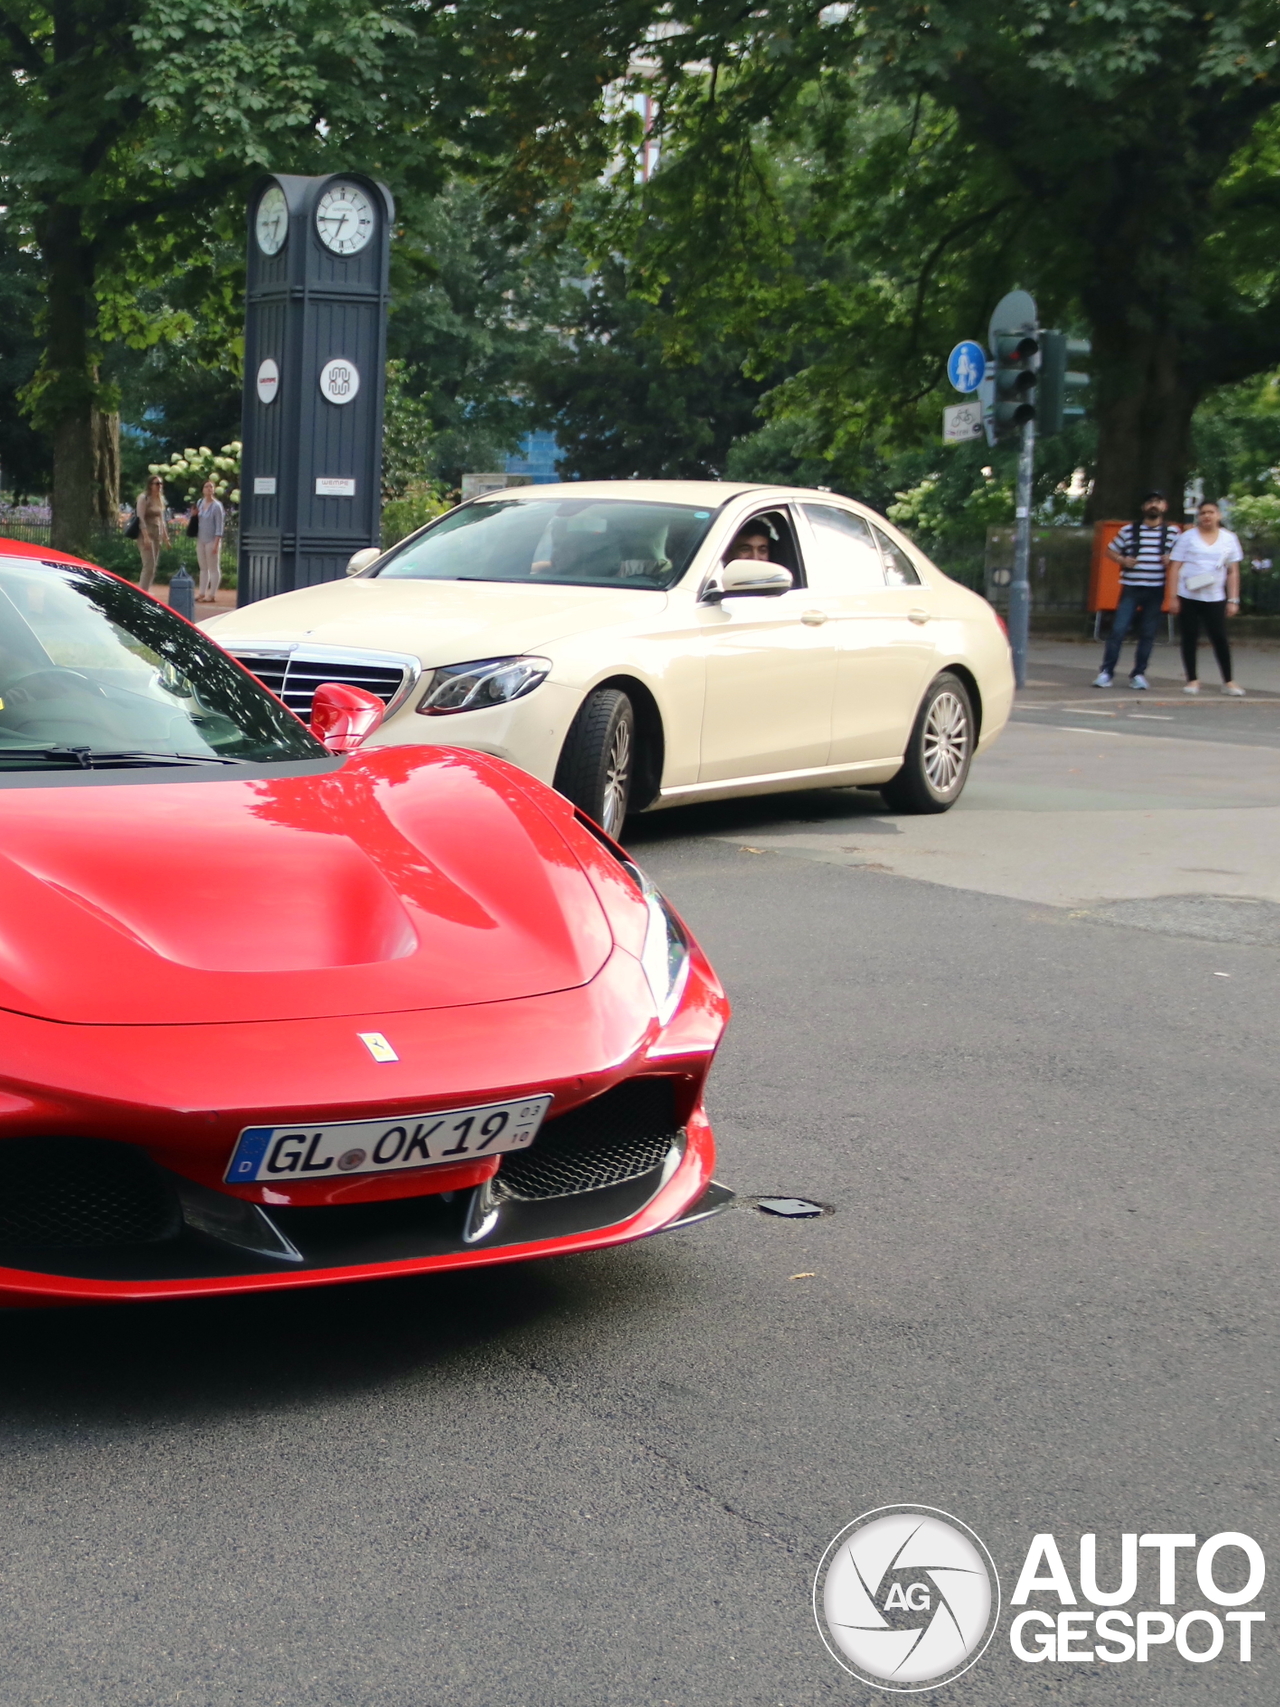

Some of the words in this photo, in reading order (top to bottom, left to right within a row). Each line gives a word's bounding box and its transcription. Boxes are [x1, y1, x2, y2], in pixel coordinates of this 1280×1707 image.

[520, 1105, 541, 1119] 03
[266, 1133, 334, 1173] GL
[372, 1119, 446, 1164] OK
[442, 1111, 510, 1157] 19
[510, 1131, 526, 1144] 10
[238, 1160, 253, 1173] D
